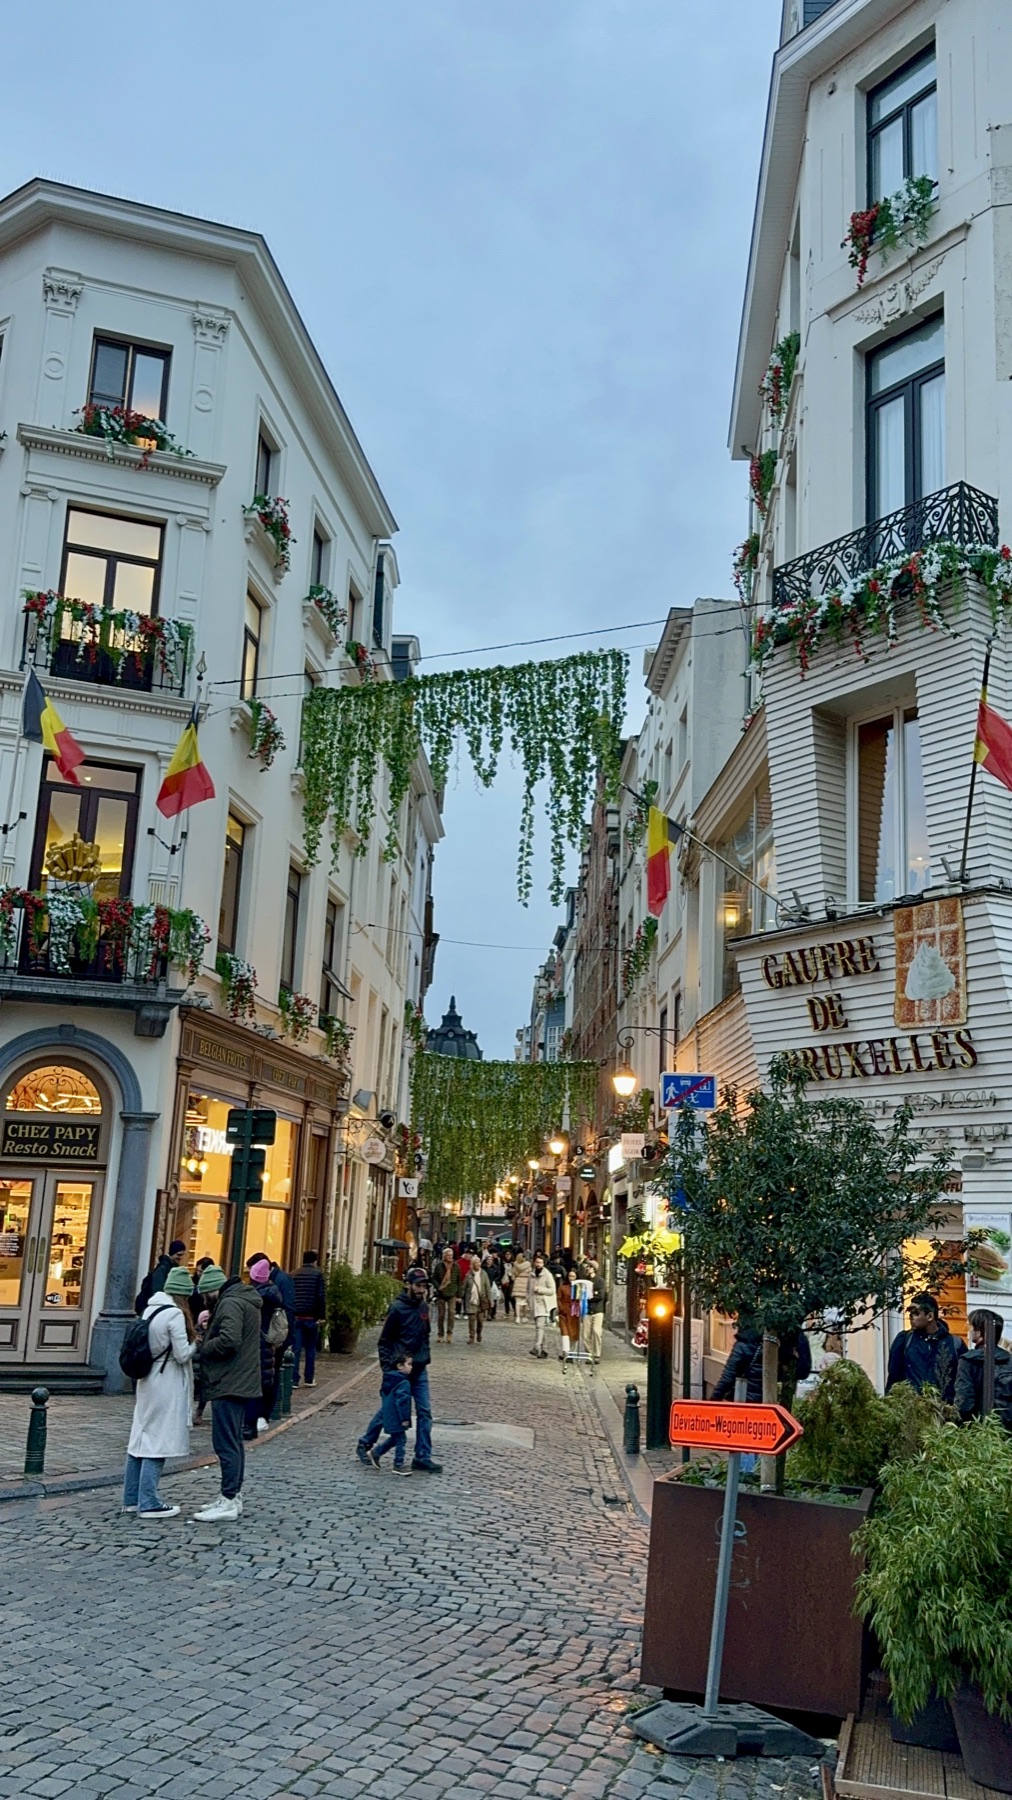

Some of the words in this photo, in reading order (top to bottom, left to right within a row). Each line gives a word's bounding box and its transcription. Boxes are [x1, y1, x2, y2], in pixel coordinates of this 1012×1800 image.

[760, 936, 880, 990] GAUFRE
[806, 993, 848, 1032] DE
[199, 1039, 226, 1063] BELGIAN
[7, 1124, 50, 1139] CHEZ
[54, 1126, 97, 1141] PAPY
[3, 1140, 48, 1155] Resto
[51, 1142, 97, 1157] Snack
[673, 1413, 777, 1441] Déviation-Wegomlegging
